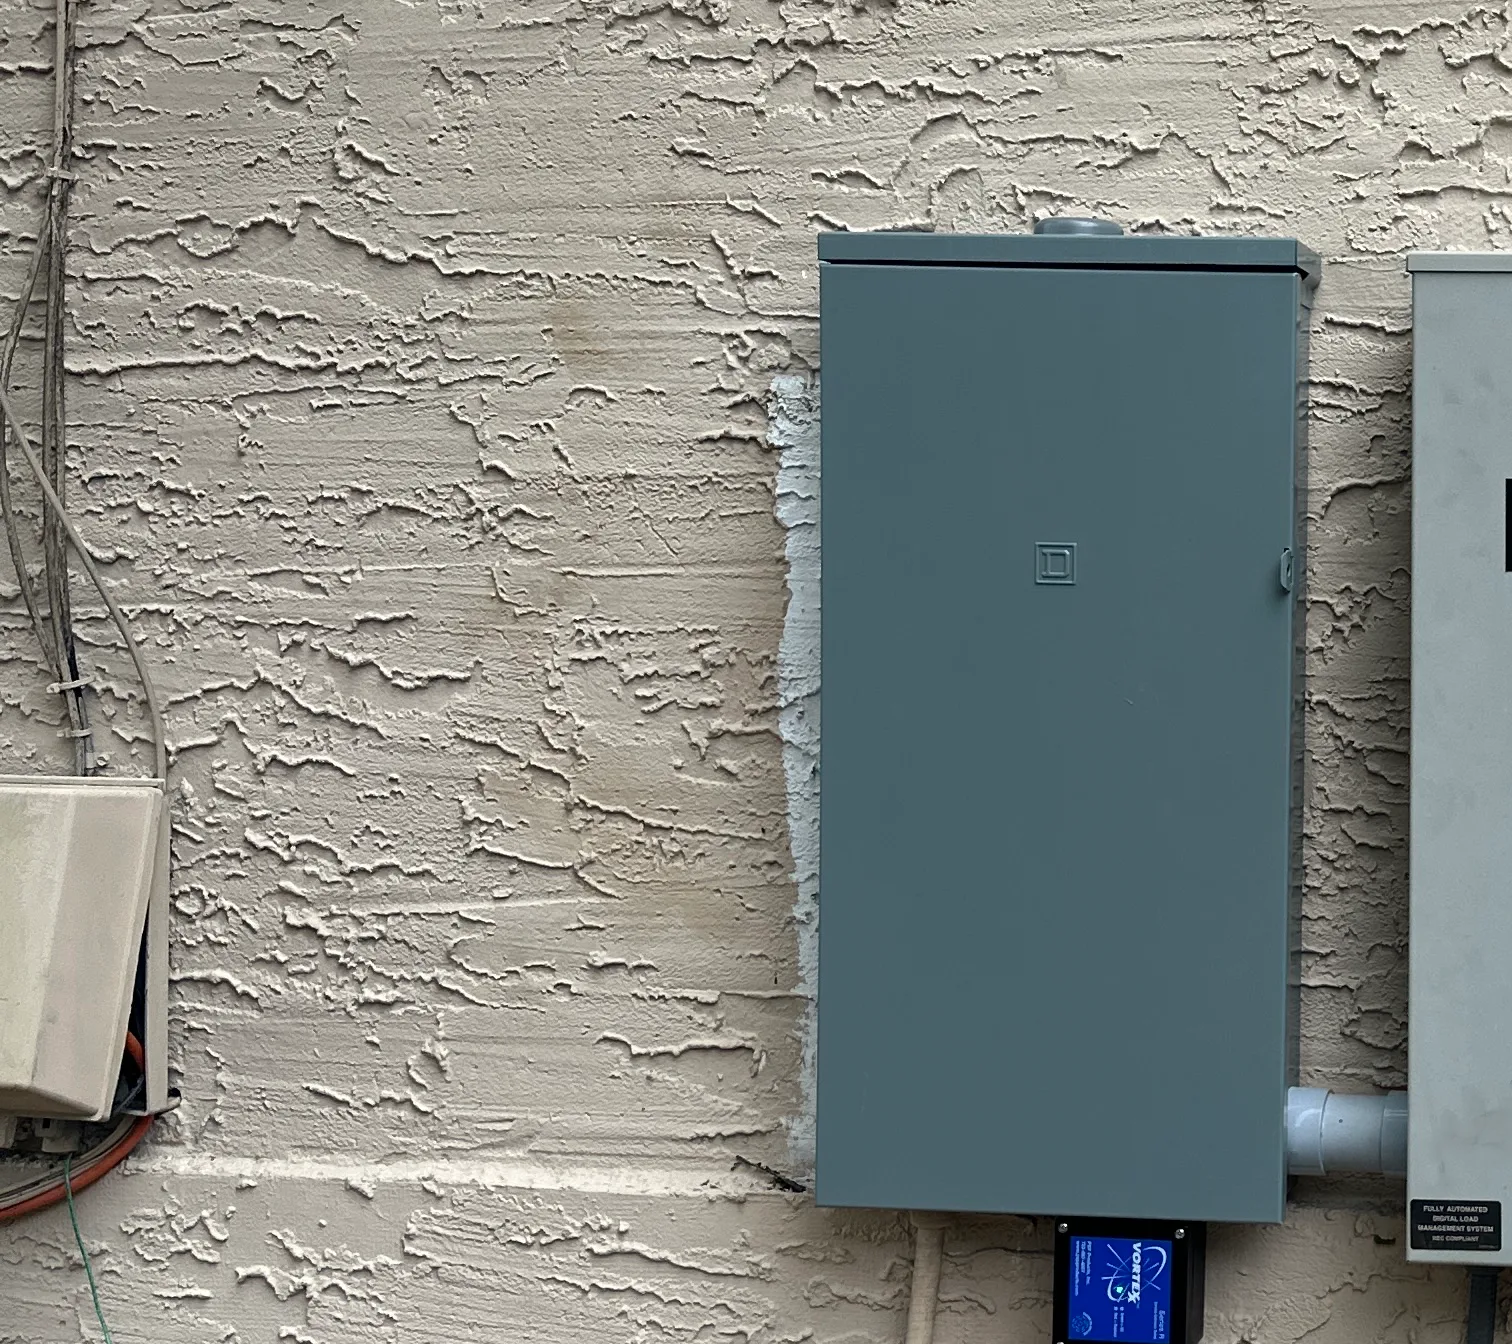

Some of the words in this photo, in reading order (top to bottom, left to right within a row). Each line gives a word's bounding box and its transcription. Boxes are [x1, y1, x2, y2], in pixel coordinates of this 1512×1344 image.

[1446, 1205, 1489, 1213] AUTOMATED
[1459, 1215, 1479, 1223] LOAD
[1417, 1224, 1466, 1232] MANAGEMENT
[1466, 1225, 1494, 1233] SYSTEM
